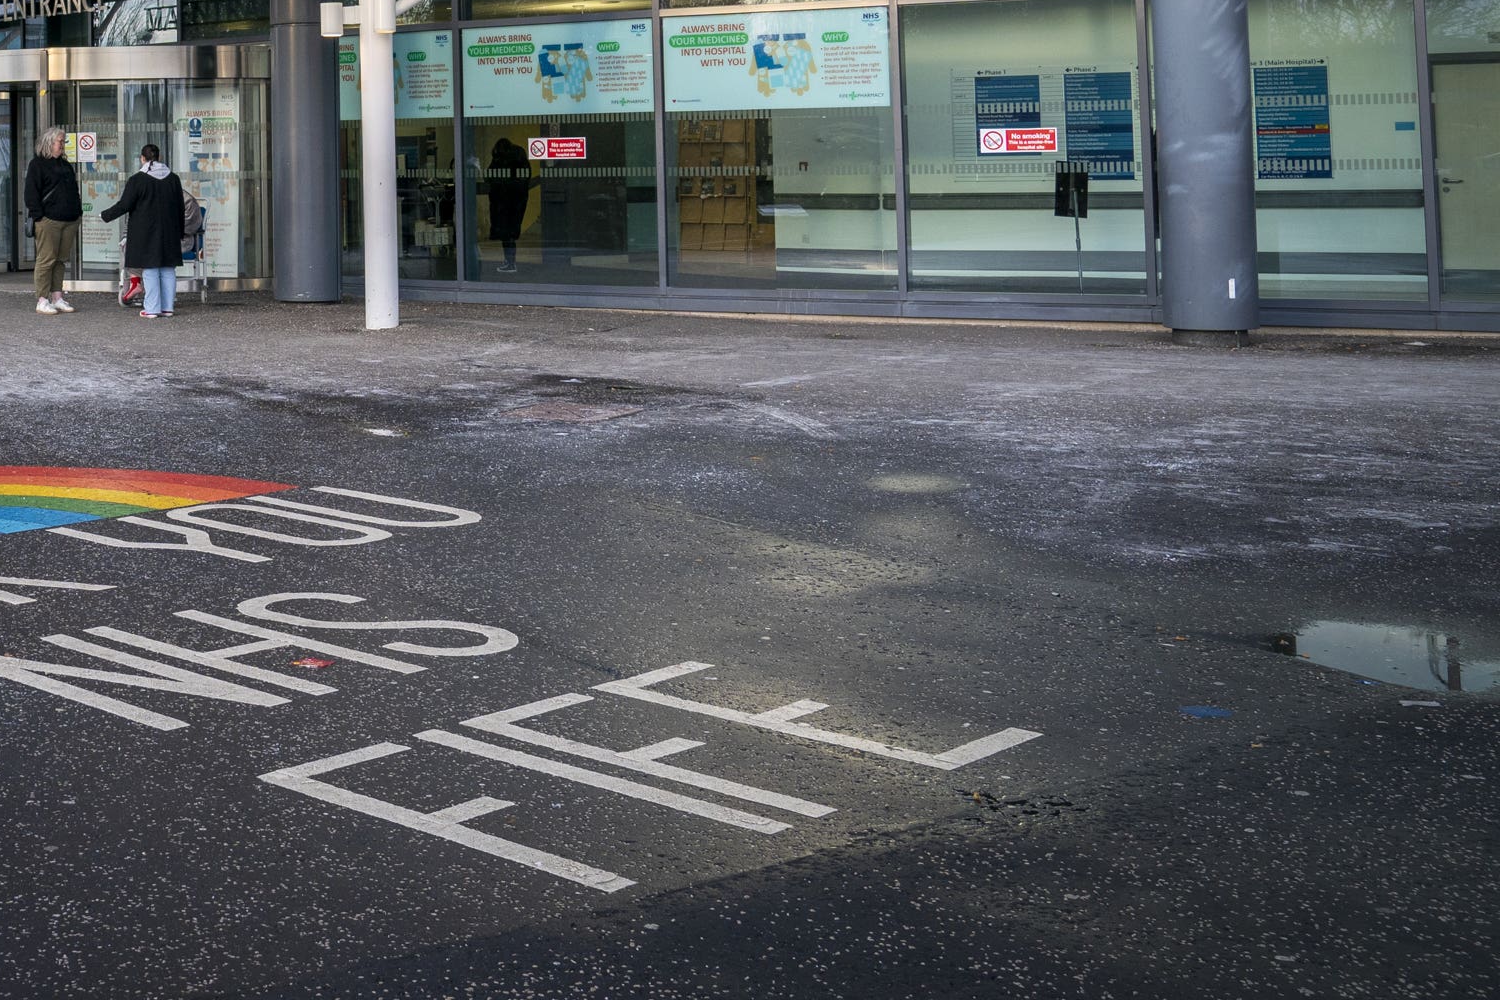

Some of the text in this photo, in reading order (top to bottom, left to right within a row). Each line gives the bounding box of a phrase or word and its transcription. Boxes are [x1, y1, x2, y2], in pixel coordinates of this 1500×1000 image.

[681, 23, 745, 34] ALWAYS BRING
[477, 34, 532, 44] ALWAYS BRING
[671, 35, 746, 46] YOUR MEDICINES
[824, 32, 848, 41] WHY?
[468, 45, 533, 55] YOUR MEDICINES
[598, 43, 618, 51] WHY?
[681, 46, 746, 57] INTO HOSPITAL
[477, 56, 532, 65] INTO HOSPITAL
[700, 58, 746, 67] WITH YOU
[1286, 58, 1317, 66] Hospital)
[494, 67, 514, 75] WITH
[46, 485, 482, 563] YOU
[257, 659, 1044, 893] FIFE
